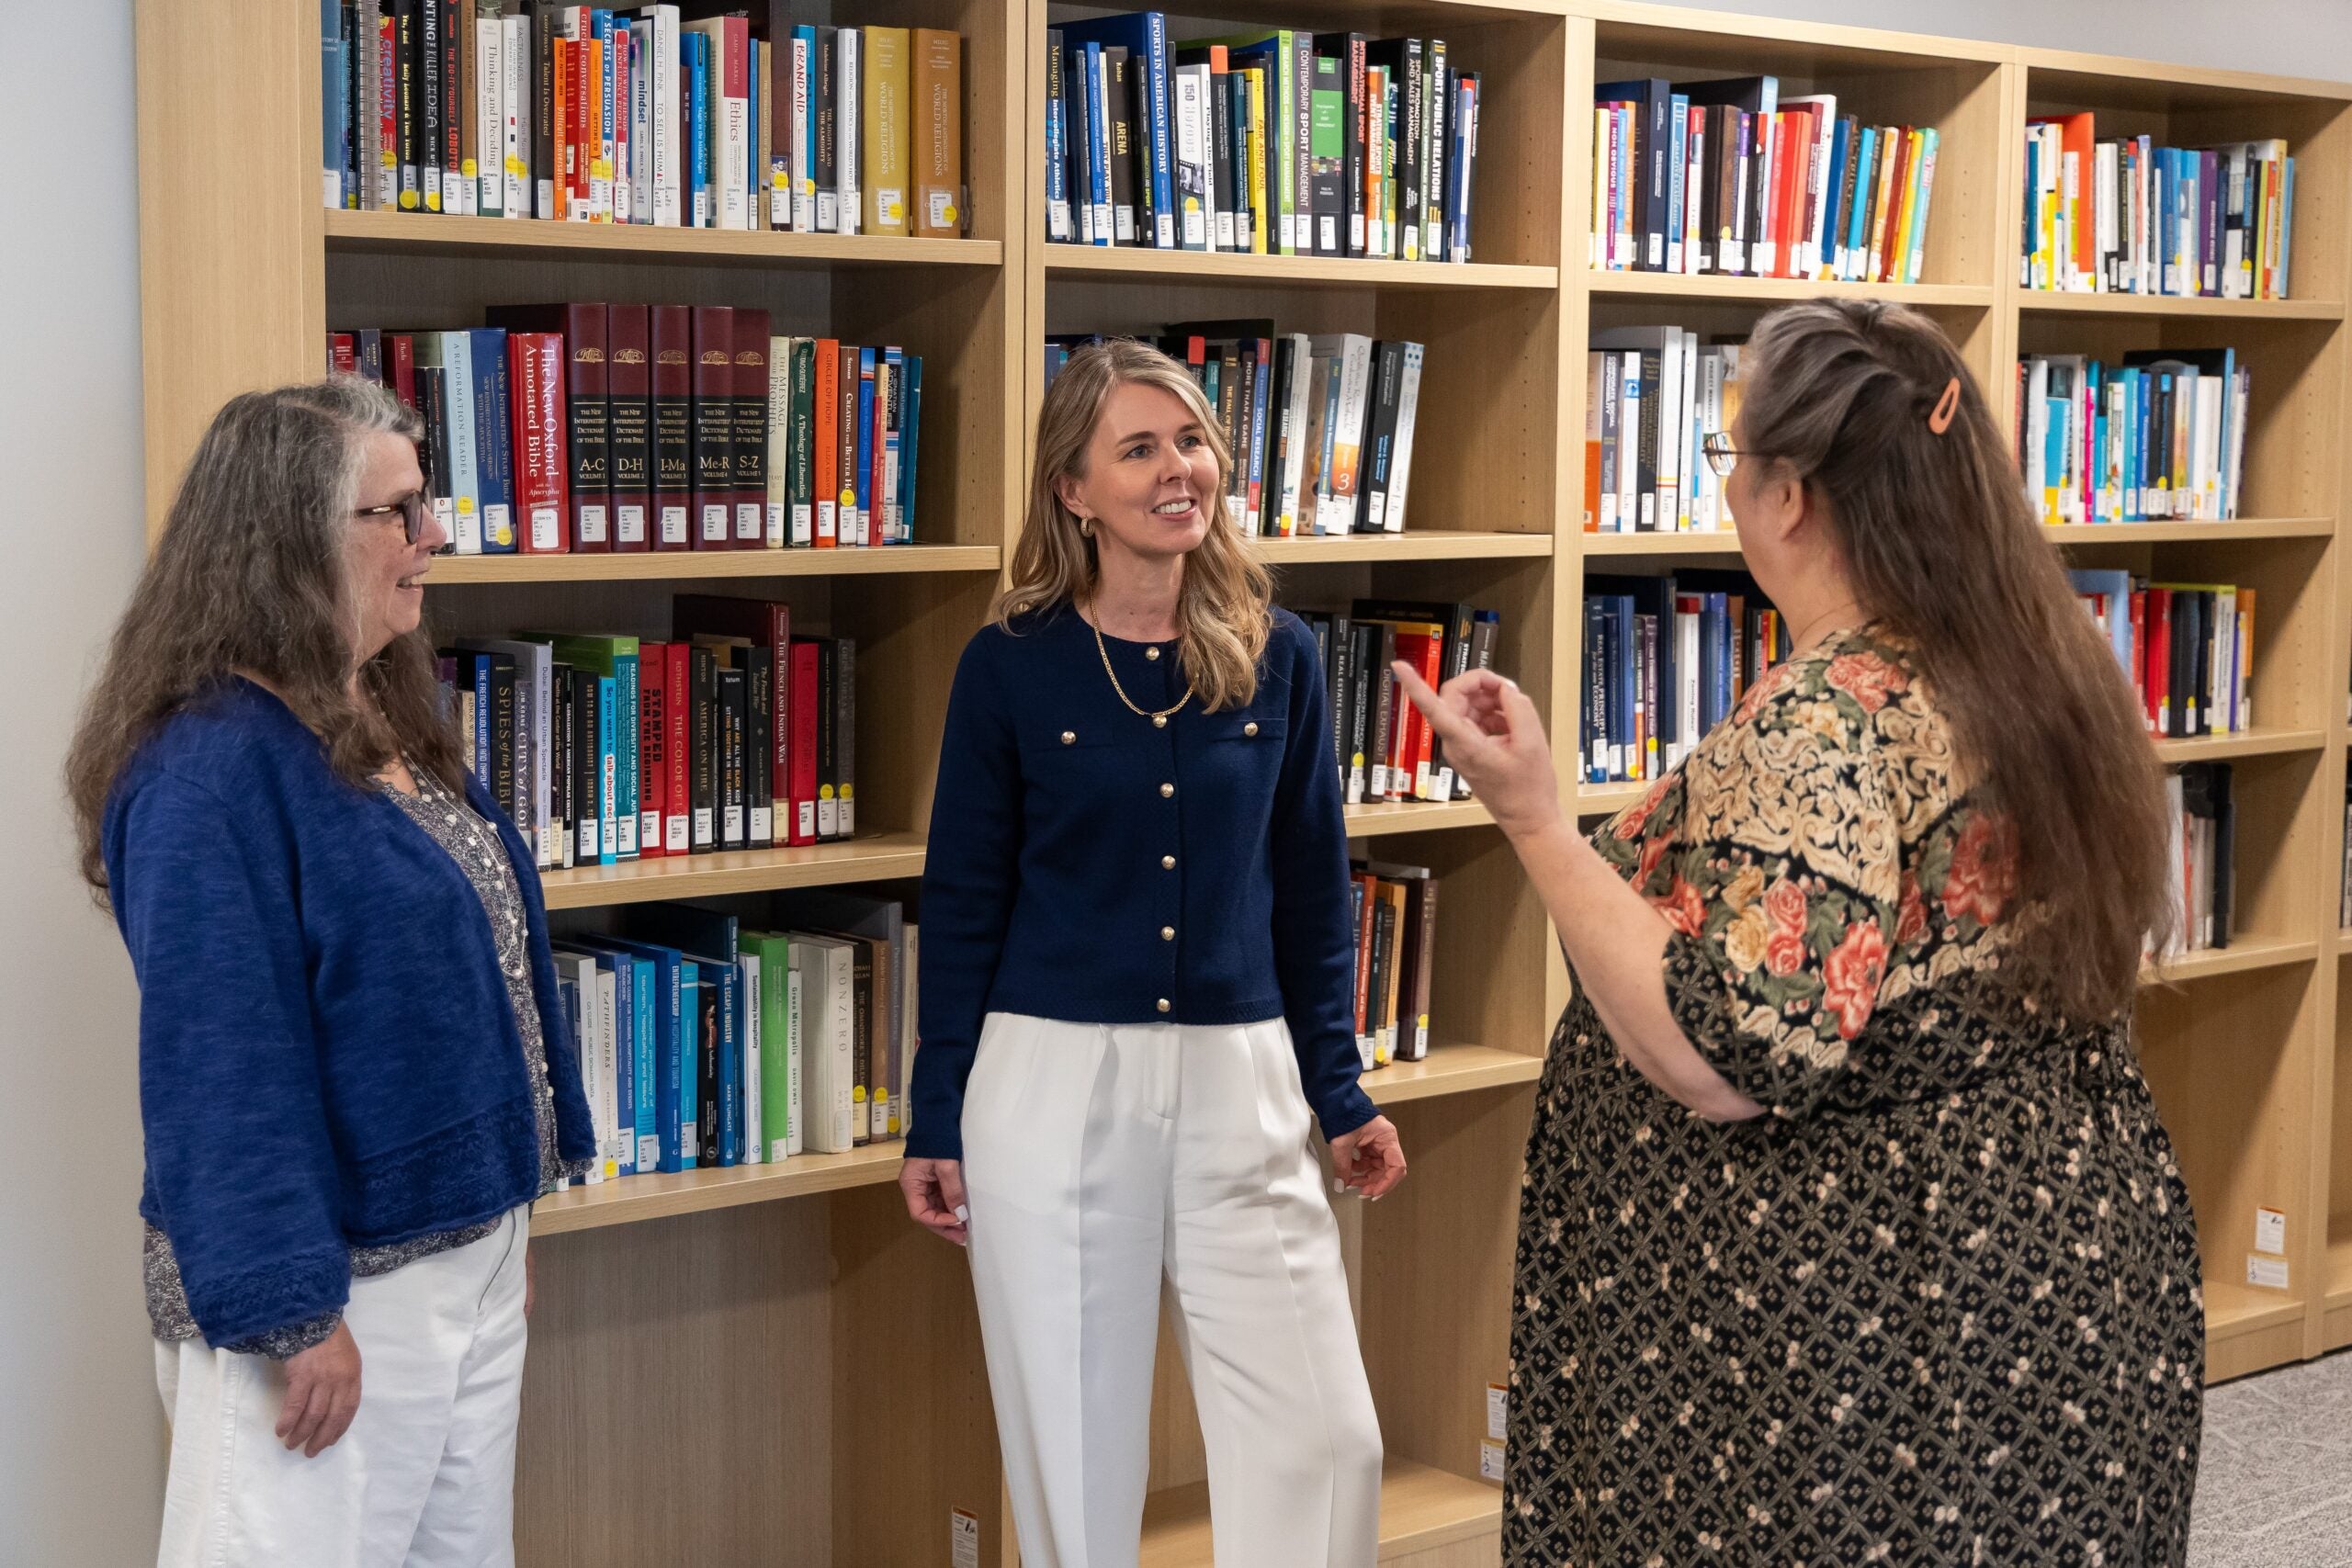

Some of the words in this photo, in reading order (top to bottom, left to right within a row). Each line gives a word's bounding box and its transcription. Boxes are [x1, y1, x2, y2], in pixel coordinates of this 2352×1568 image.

[425, 0, 437, 40] NTING
[580, 14, 588, 51] crucial
[1152, 18, 1162, 55] SPORTS
[604, 22, 612, 62] SECRETS
[382, 39, 395, 119] creativity
[426, 51, 437, 81] KILLER
[487, 44, 498, 94] Thinking
[543, 62, 551, 86] Talent
[605, 64, 611, 73] of
[796, 45, 805, 89] BRAND
[1050, 46, 1060, 97] Managing
[1154, 59, 1163, 69] IN
[1300, 50, 1309, 110] CONTEMPORARY
[1434, 56, 1443, 94] SPORT
[426, 85, 437, 129] IDEA
[580, 55, 588, 129] conversations
[604, 76, 612, 134] PERSUASION
[638, 81, 647, 123] mindset
[656, 103, 663, 115] TO
[797, 92, 805, 112] AID
[879, 81, 888, 119] WORLD
[933, 83, 943, 121] WORLD
[1155, 73, 1165, 127] AMERICAN
[543, 97, 551, 137] Overrated
[557, 107, 565, 138] Difficult
[729, 101, 742, 141] Ethics
[1052, 99, 1060, 160] Intercollegiate
[1300, 112, 1309, 151] SPORT
[1433, 96, 1442, 136] PUBLIC
[487, 119, 498, 167] Deciding
[879, 121, 888, 175] RELIGIONS
[933, 123, 943, 176] RELIGIONS
[1117, 121, 1128, 154] ARENA
[1157, 130, 1167, 175] HISTORY
[1300, 153, 1308, 209] MANAGEMENT
[1431, 140, 1441, 200] RELATIONS
[540, 346, 555, 377] The
[454, 353, 465, 430] REFORMATION
[526, 344, 539, 431] Annotated
[542, 379, 557, 415] New
[825, 388, 832, 399] OF
[797, 422, 807, 453] Theology
[1255, 408, 1263, 435] SOCIAL
[458, 435, 467, 476] READER
[527, 436, 541, 478] Bible
[543, 418, 560, 476] Oxford
[580, 458, 605, 471] A-C
[619, 459, 643, 471] D-H
[662, 459, 685, 471] I-Ma
[700, 457, 729, 468] Me-R
[740, 456, 759, 468] S-Z
[1253, 437, 1261, 476] RESEARCH
[1338, 473, 1350, 491] 3
[778, 641, 786, 658] THE
[606, 687, 614, 697] So
[778, 660, 786, 692] FRENCH
[1380, 669, 1391, 707] DIGITAL
[499, 687, 511, 739] SPIES
[643, 689, 652, 718] FROM
[1597, 689, 1605, 739] PRINCIPLE
[643, 721, 652, 742] THE
[652, 689, 662, 762] STAMPED
[674, 715, 684, 738] THE
[699, 700, 707, 746] AMERICA
[778, 714, 786, 742] INDIAN
[500, 742, 510, 751] of
[502, 754, 511, 766] the
[606, 742, 614, 751] to
[674, 740, 684, 781] COLOR
[699, 750, 707, 763] ON
[778, 744, 786, 764] WAR
[643, 746, 652, 801] BEGINNING
[674, 784, 684, 799] OF
[699, 768, 707, 792] FIRE
[672, 966, 680, 1016] ENTREPRENEURSHIP
[838, 963, 847, 1053] NONZERO
[603, 989, 611, 1069] PATHFINDERS
[649, 1099, 654, 1108] of
